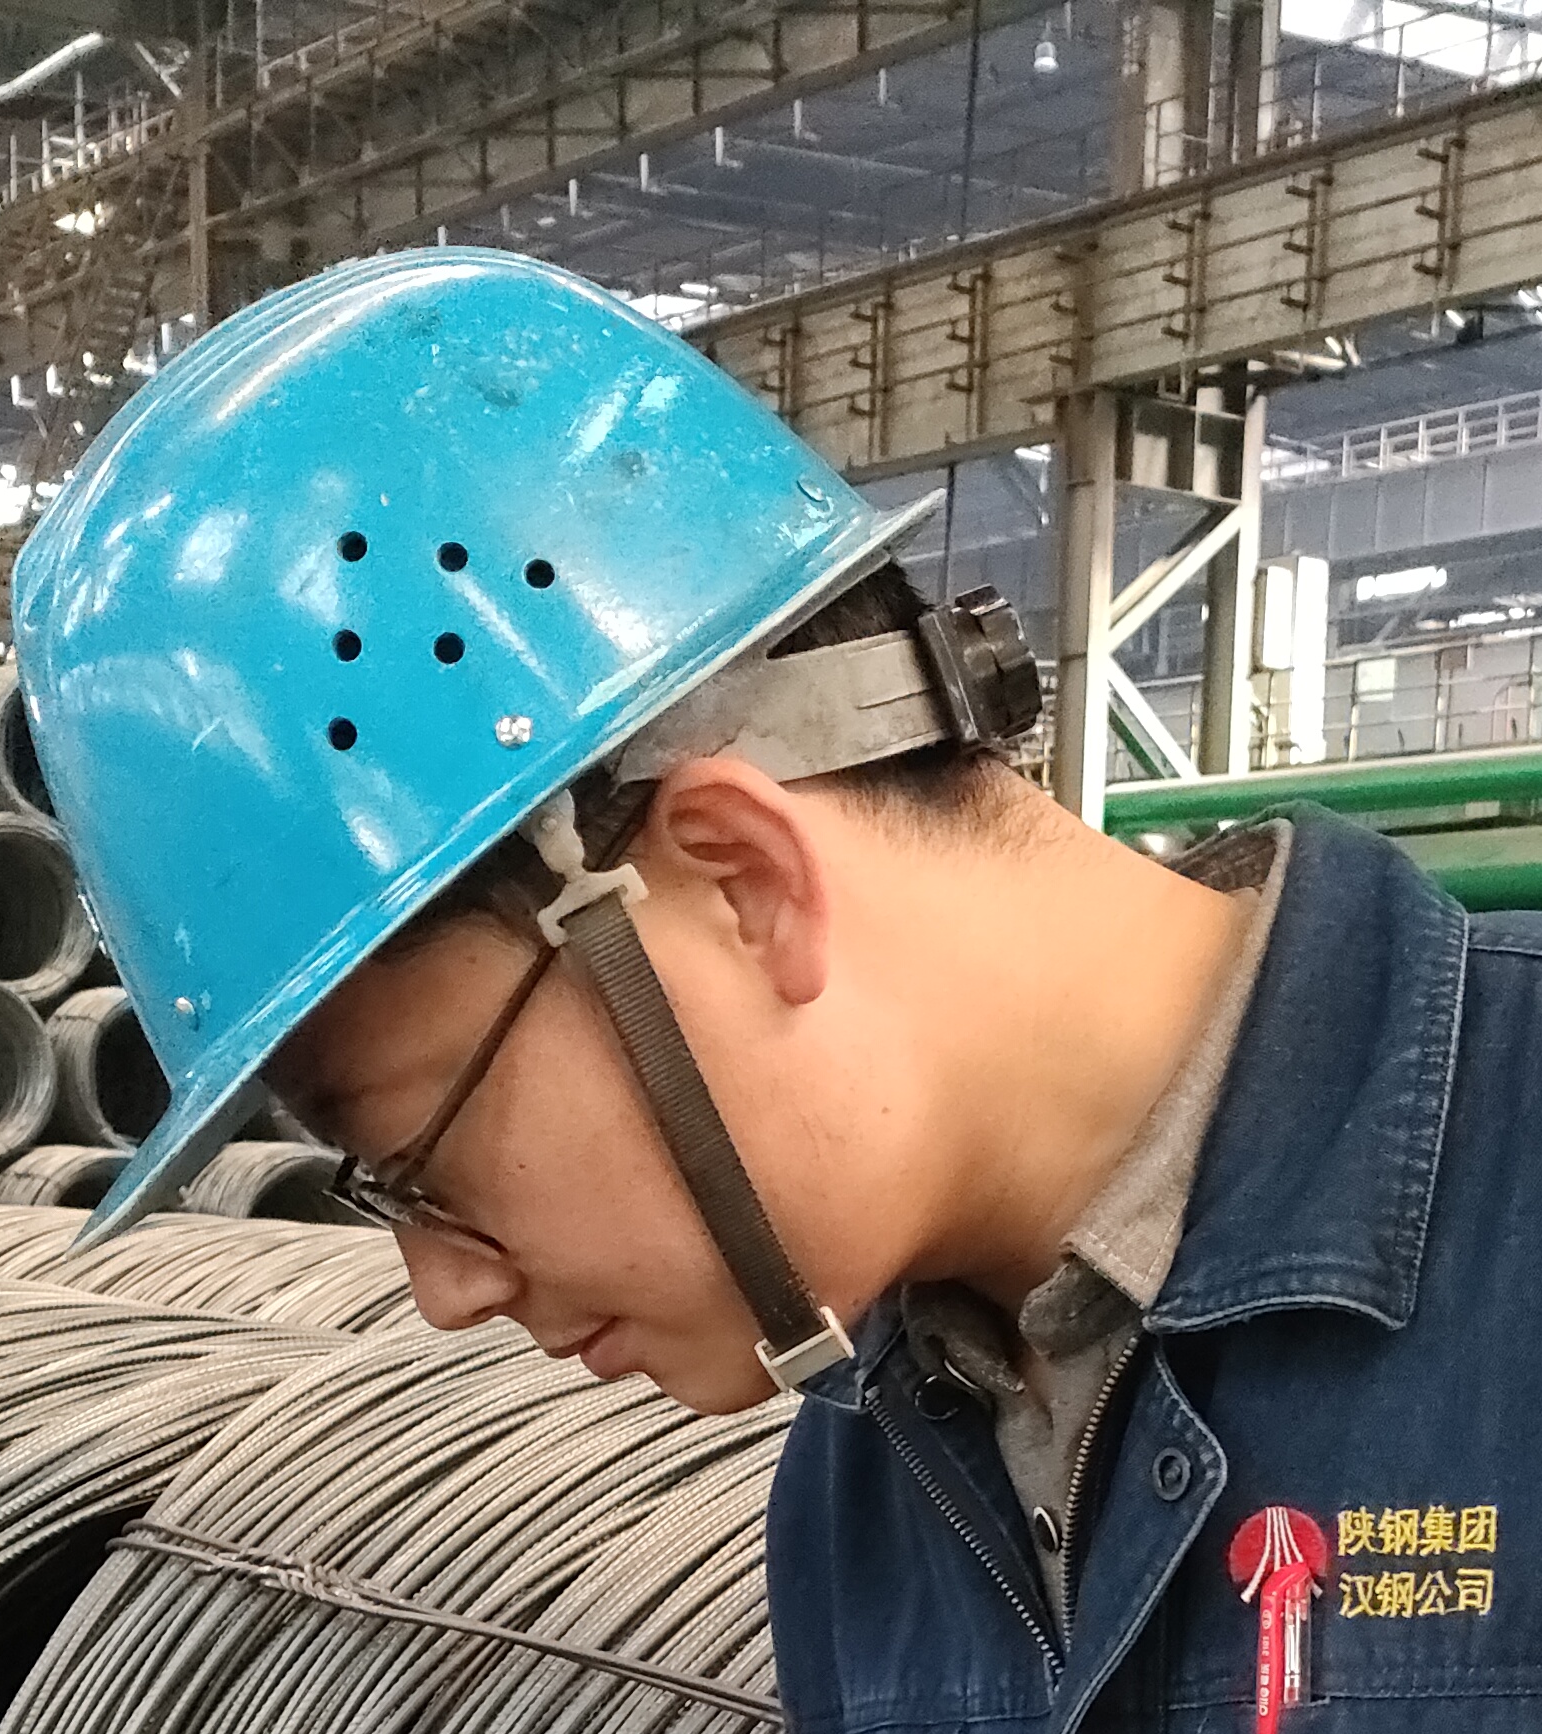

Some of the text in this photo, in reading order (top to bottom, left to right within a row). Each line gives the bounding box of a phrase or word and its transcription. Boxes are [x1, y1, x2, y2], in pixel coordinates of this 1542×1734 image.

[1337, 1504, 1498, 1557] 陕钢集团
[1338, 1567, 1495, 1619] 汉钢公司
